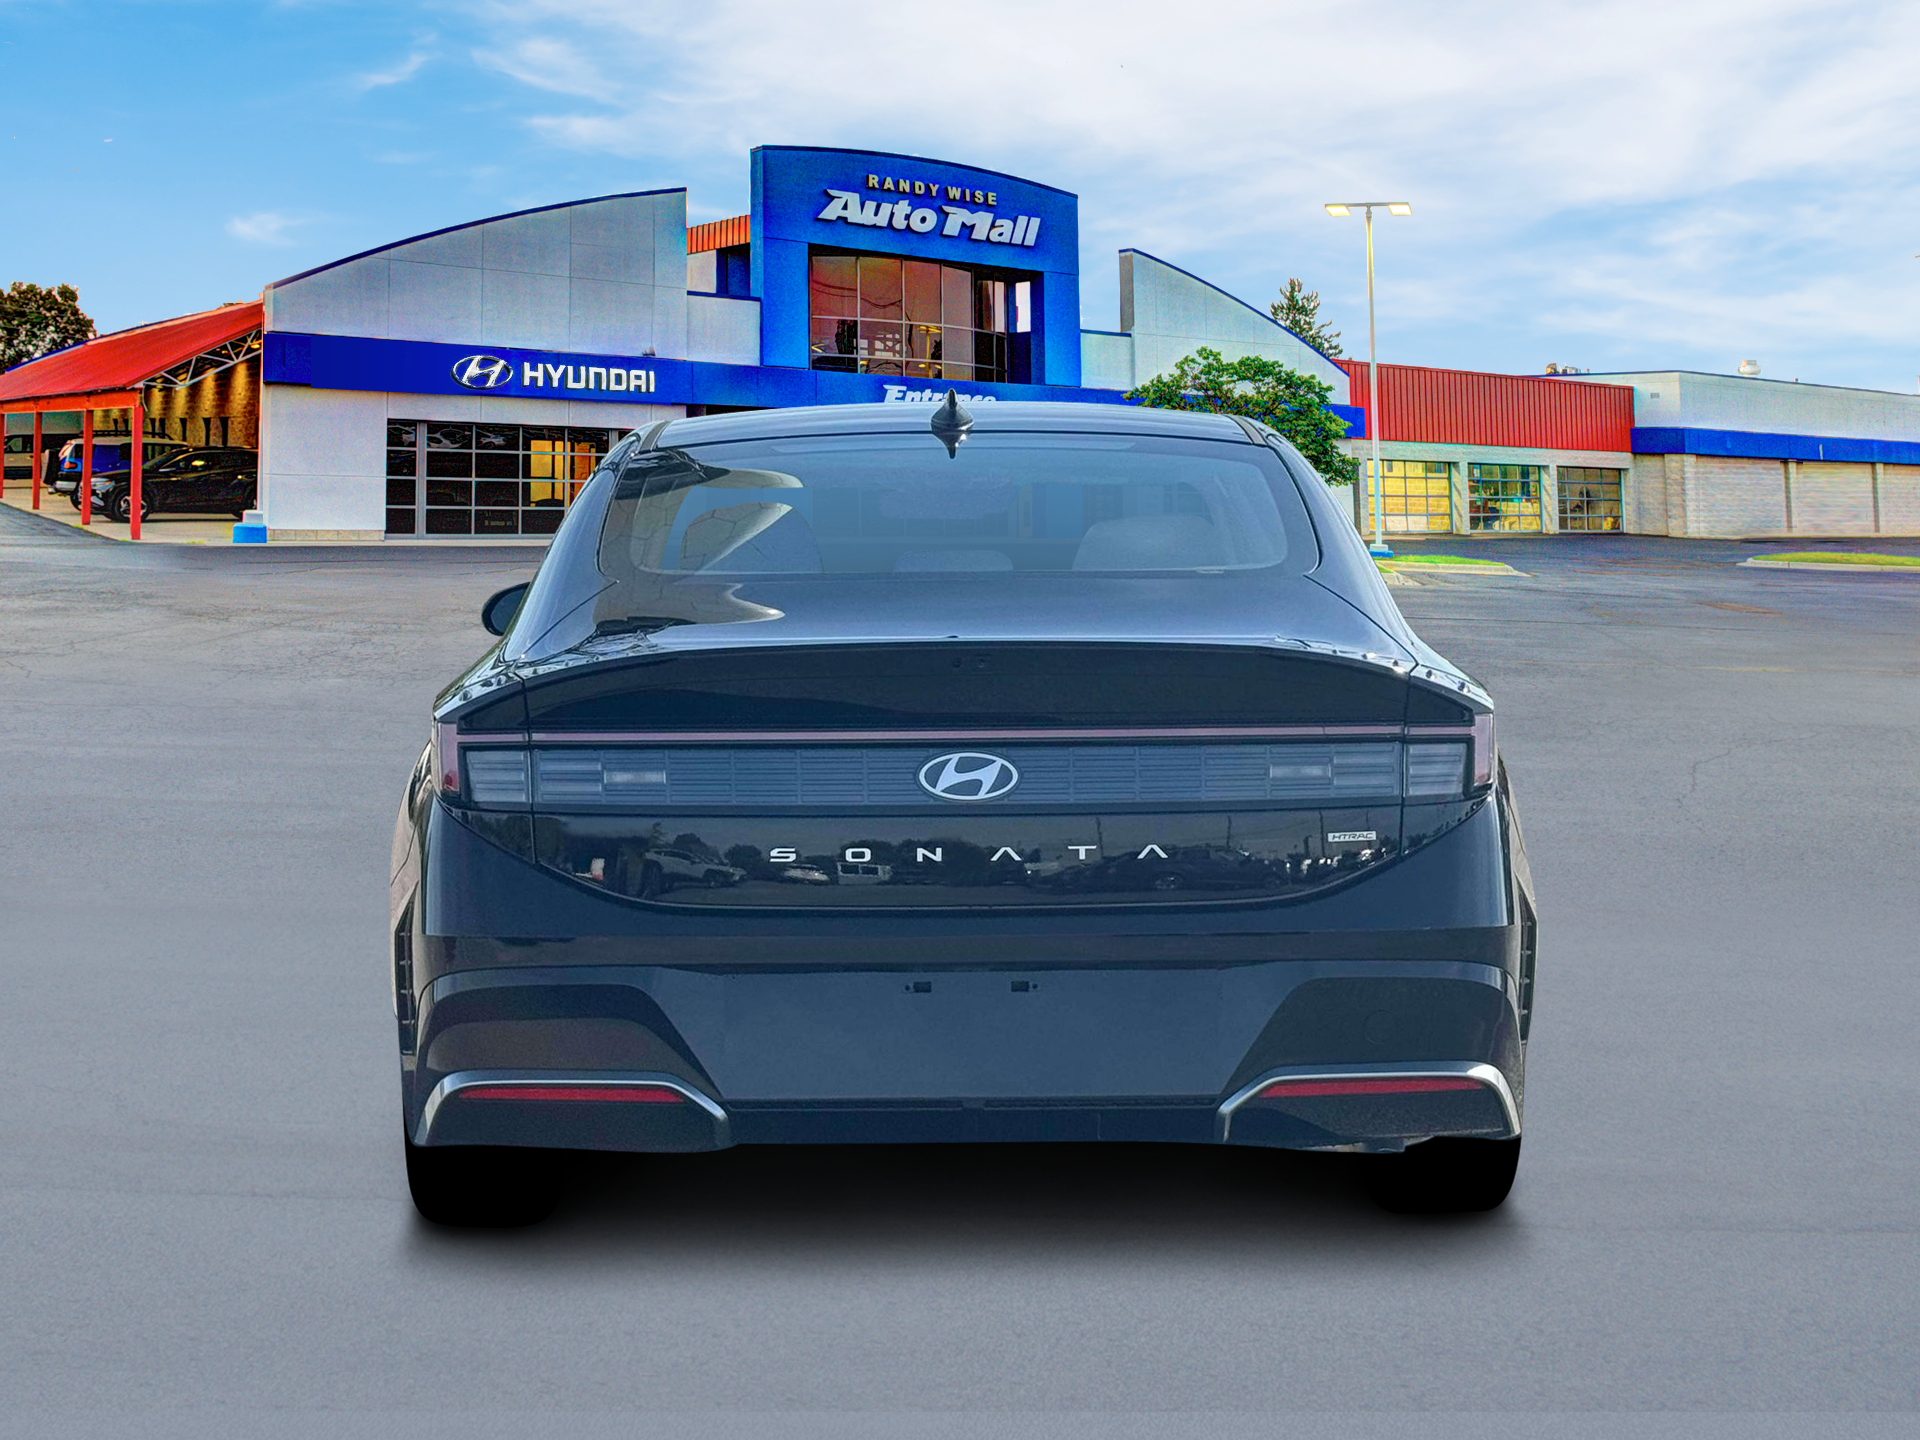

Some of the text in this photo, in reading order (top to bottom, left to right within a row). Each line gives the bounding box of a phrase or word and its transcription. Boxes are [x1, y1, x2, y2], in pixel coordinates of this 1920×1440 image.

[866, 173, 998, 206] RANDY WISE
[817, 188, 1041, 247] Auto Mall
[521, 362, 656, 393] HYUNDAI
[883, 385, 996, 403] Entrn
[1331, 832, 1375, 841] HTRAC
[769, 844, 1169, 864] SONATA
